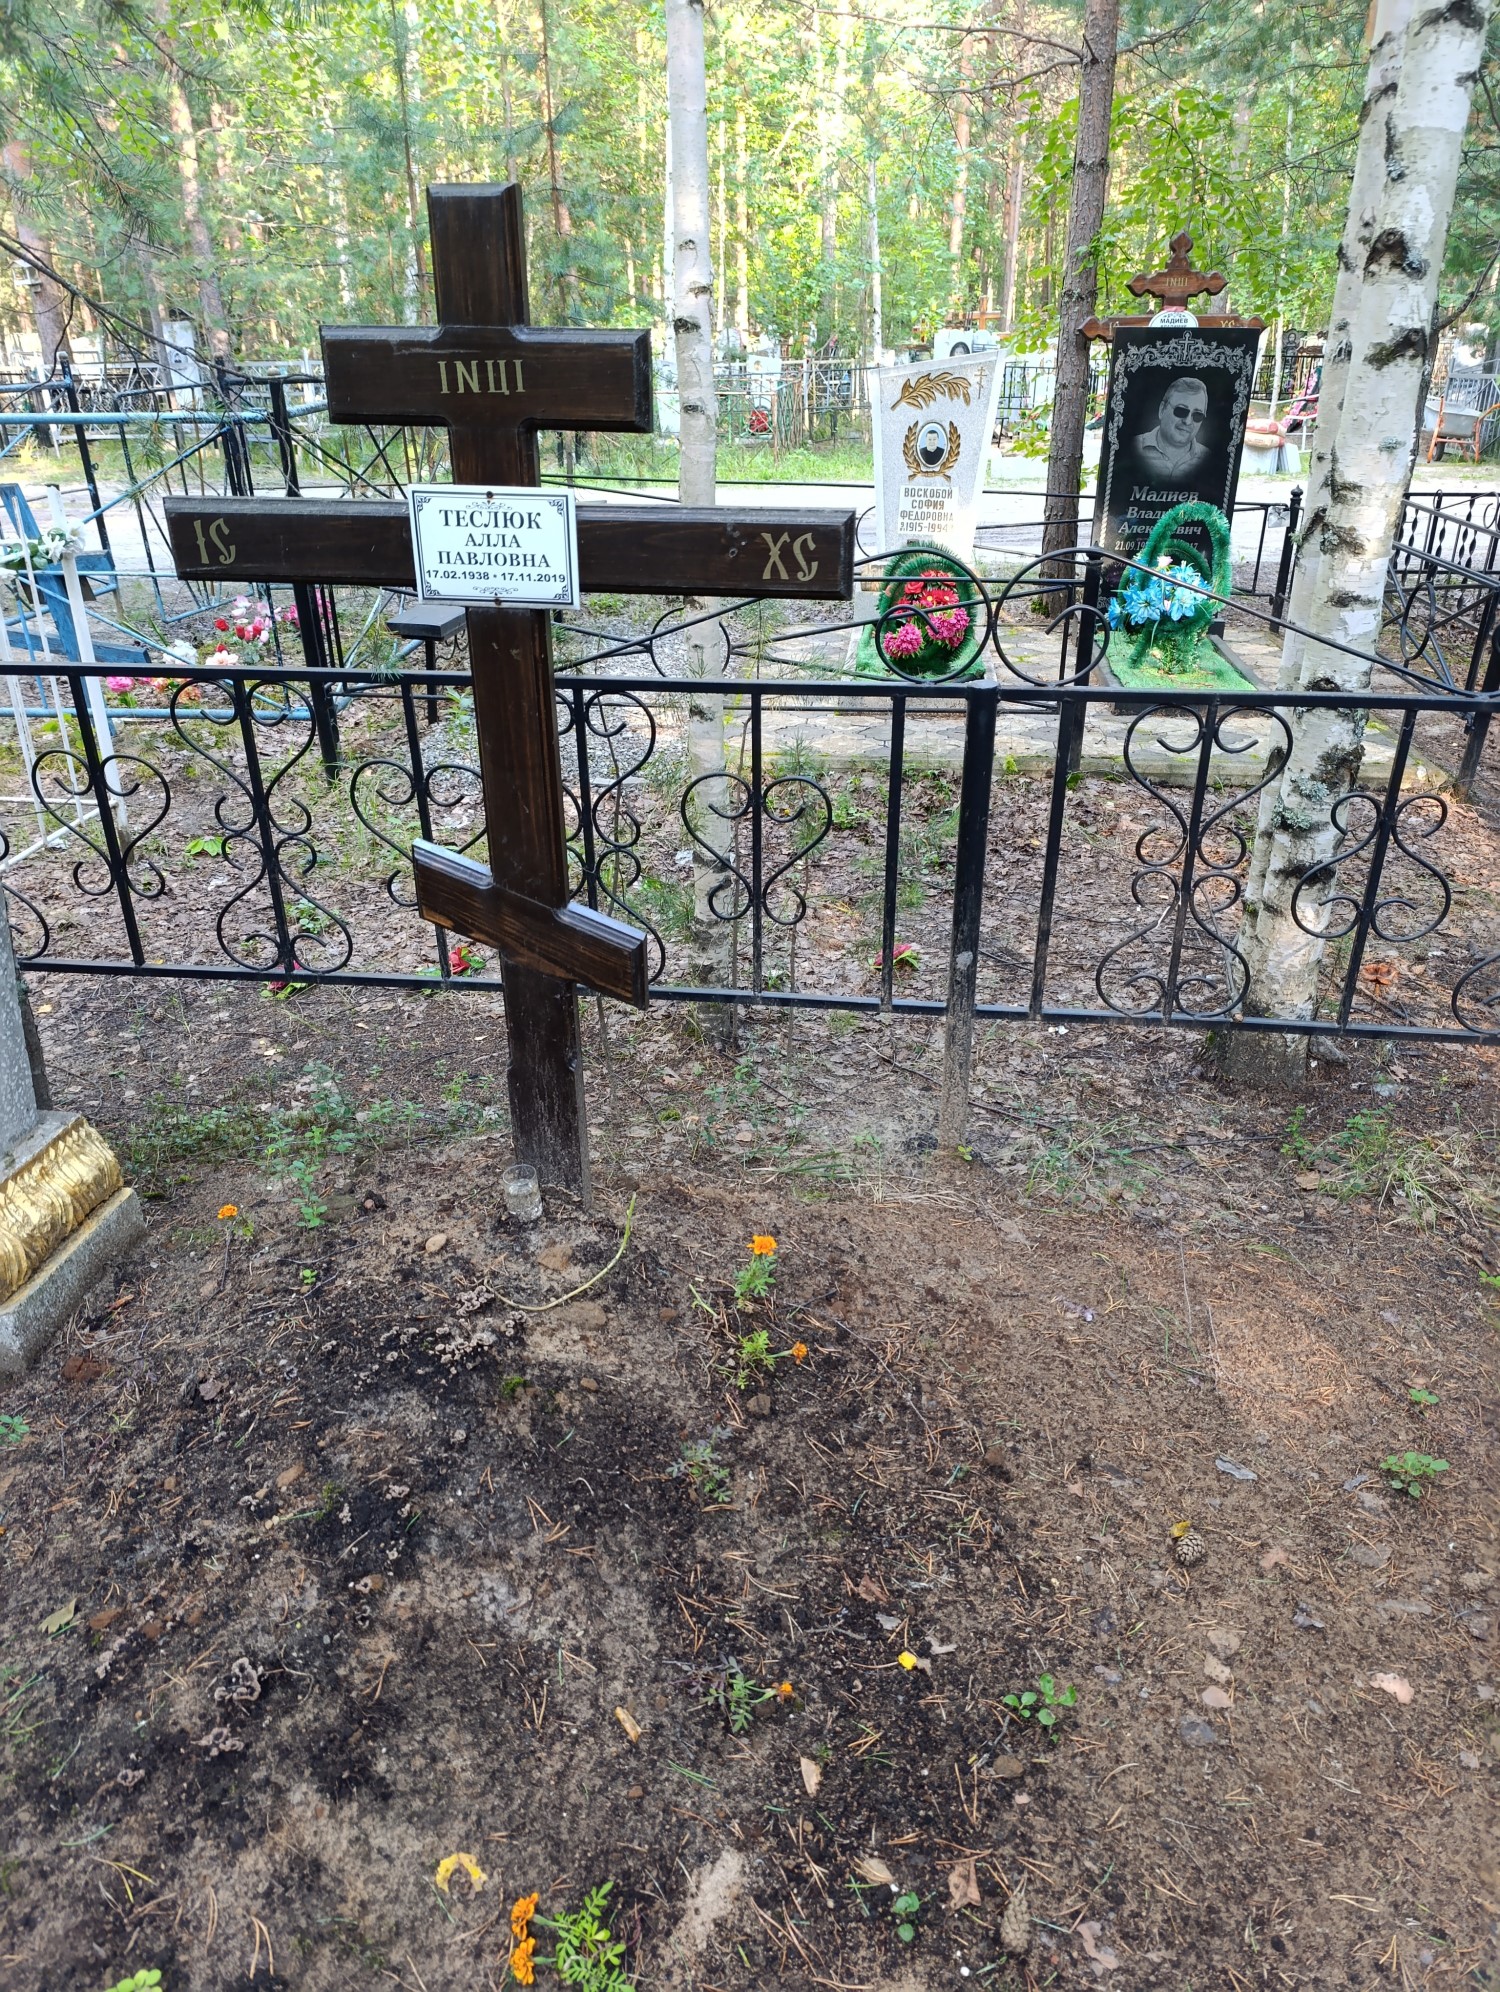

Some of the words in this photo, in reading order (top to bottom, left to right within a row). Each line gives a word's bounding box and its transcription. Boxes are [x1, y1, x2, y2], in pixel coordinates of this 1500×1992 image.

[904, 487, 953, 499] ВОСКОБОЙ
[1129, 485, 1200, 502] Мадиев
[911, 499, 945, 510] СОФИЯ
[438, 509, 542, 530] ТЕСЛЮК
[900, 510, 953, 521] ФЕДОРОВНА
[464, 532, 522, 548] АЛЛА
[437, 550, 551, 568] ПАВЛОВНА
[425, 569, 490, 581] 17.02.1938
[500, 572, 566, 583] 17.11.2019
